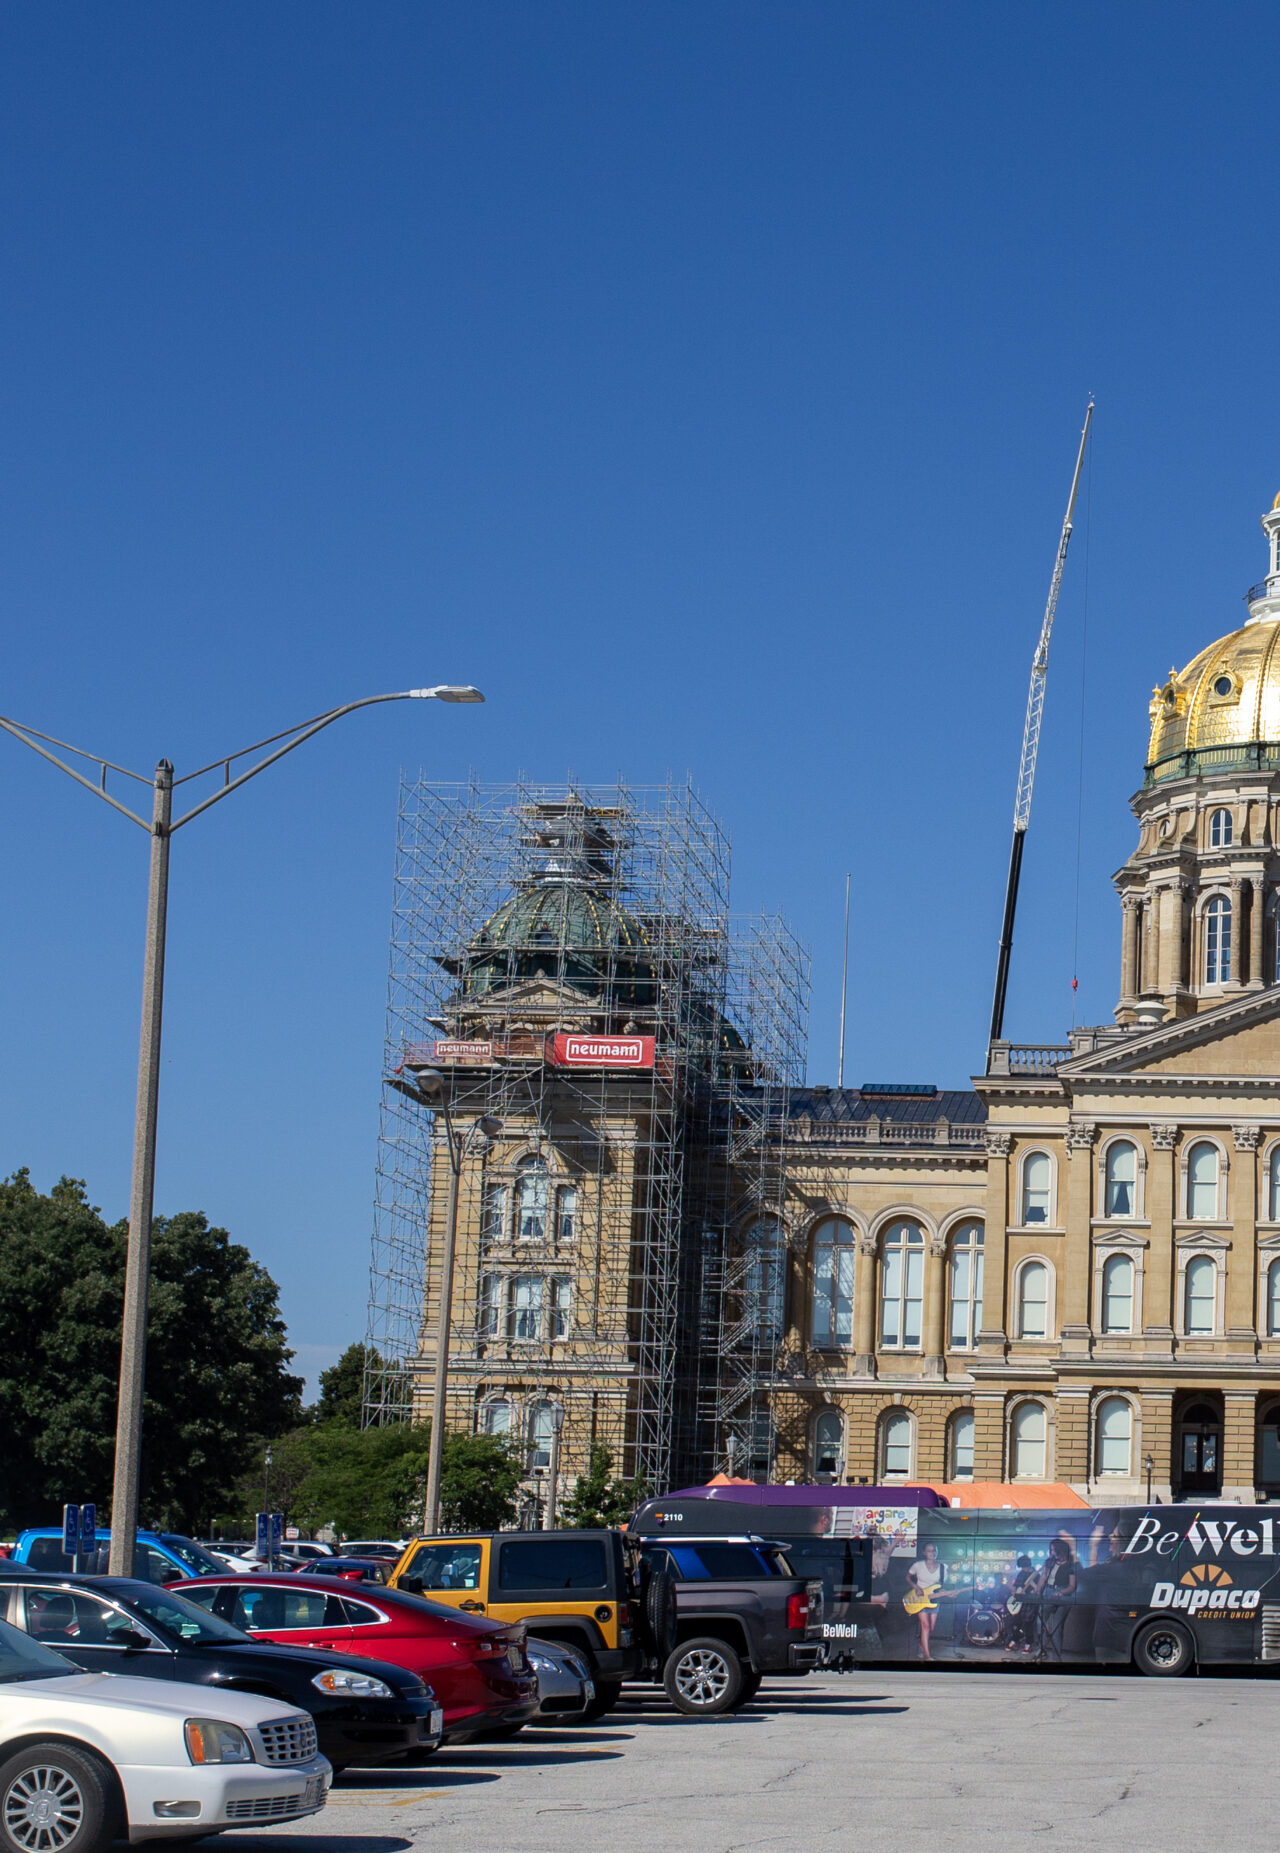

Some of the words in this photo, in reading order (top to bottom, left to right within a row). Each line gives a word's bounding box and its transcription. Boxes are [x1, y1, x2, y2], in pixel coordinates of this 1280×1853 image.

[439, 1044, 489, 1054] neumann
[571, 1043, 638, 1056] neumann
[664, 1513, 683, 1521] 2110
[1150, 1582, 1261, 1615] Dupaco
[1197, 1610, 1227, 1619] CREDIT
[1229, 1611, 1256, 1620] UNION
